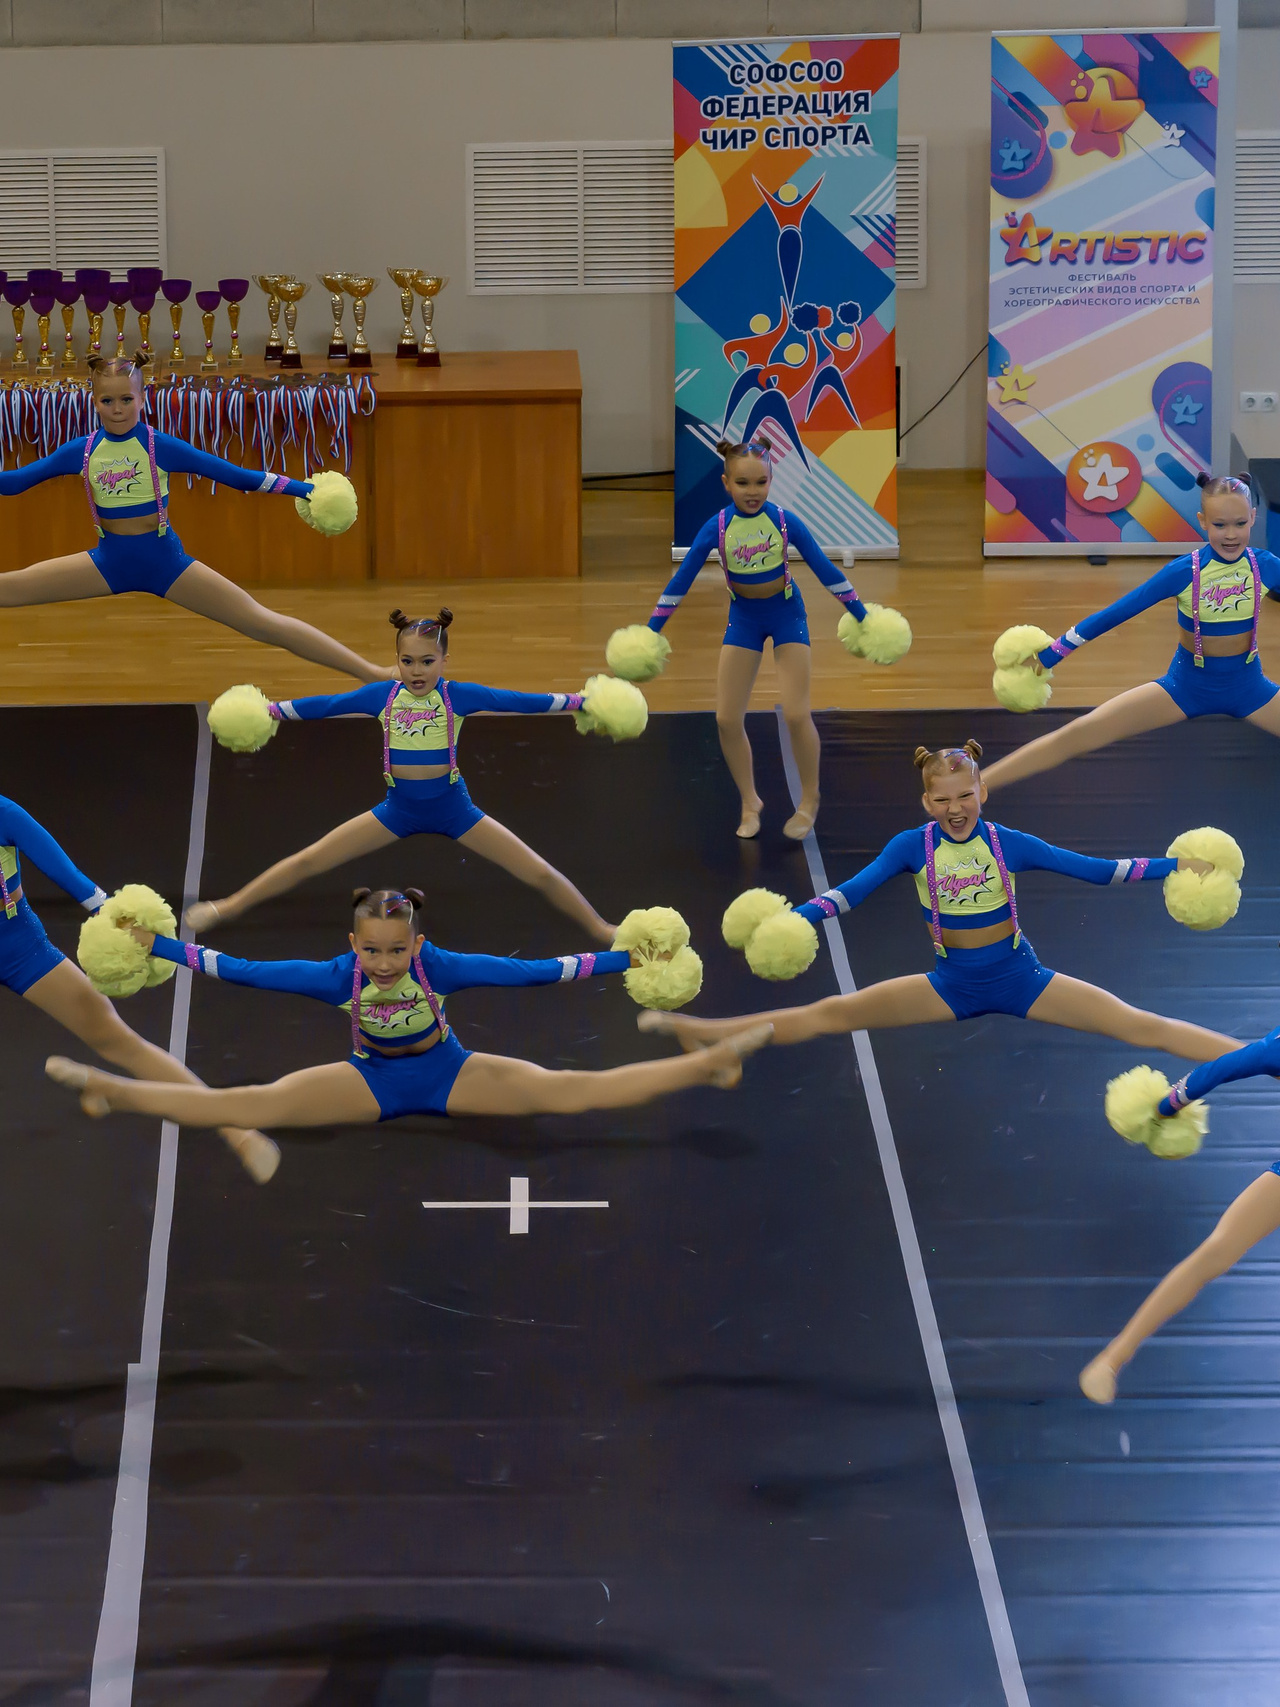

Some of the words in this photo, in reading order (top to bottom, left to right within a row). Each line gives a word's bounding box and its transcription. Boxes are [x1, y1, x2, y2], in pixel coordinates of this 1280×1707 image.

[729, 60, 843, 84] СОФСОО
[701, 91, 870, 120] ФЕДЕРАЦИЯ
[701, 128, 757, 150] ЧИР
[764, 124, 871, 149] СПОРТА
[1000, 213, 1207, 264] ARTISTIC
[1008, 286, 1094, 296] ЭСТЕТИЧЕСКИХ
[1097, 285, 1137, 295] ВИДОВ
[1139, 284, 1185, 294] СПОРТА
[1188, 284, 1196, 293] И
[1067, 273, 1137, 283] ФЕСТИВАЛЬ
[1003, 297, 1133, 308] ХОРЕОГРАФИЧЕСКОГО
[1134, 297, 1201, 306] ИСКУССТВА
